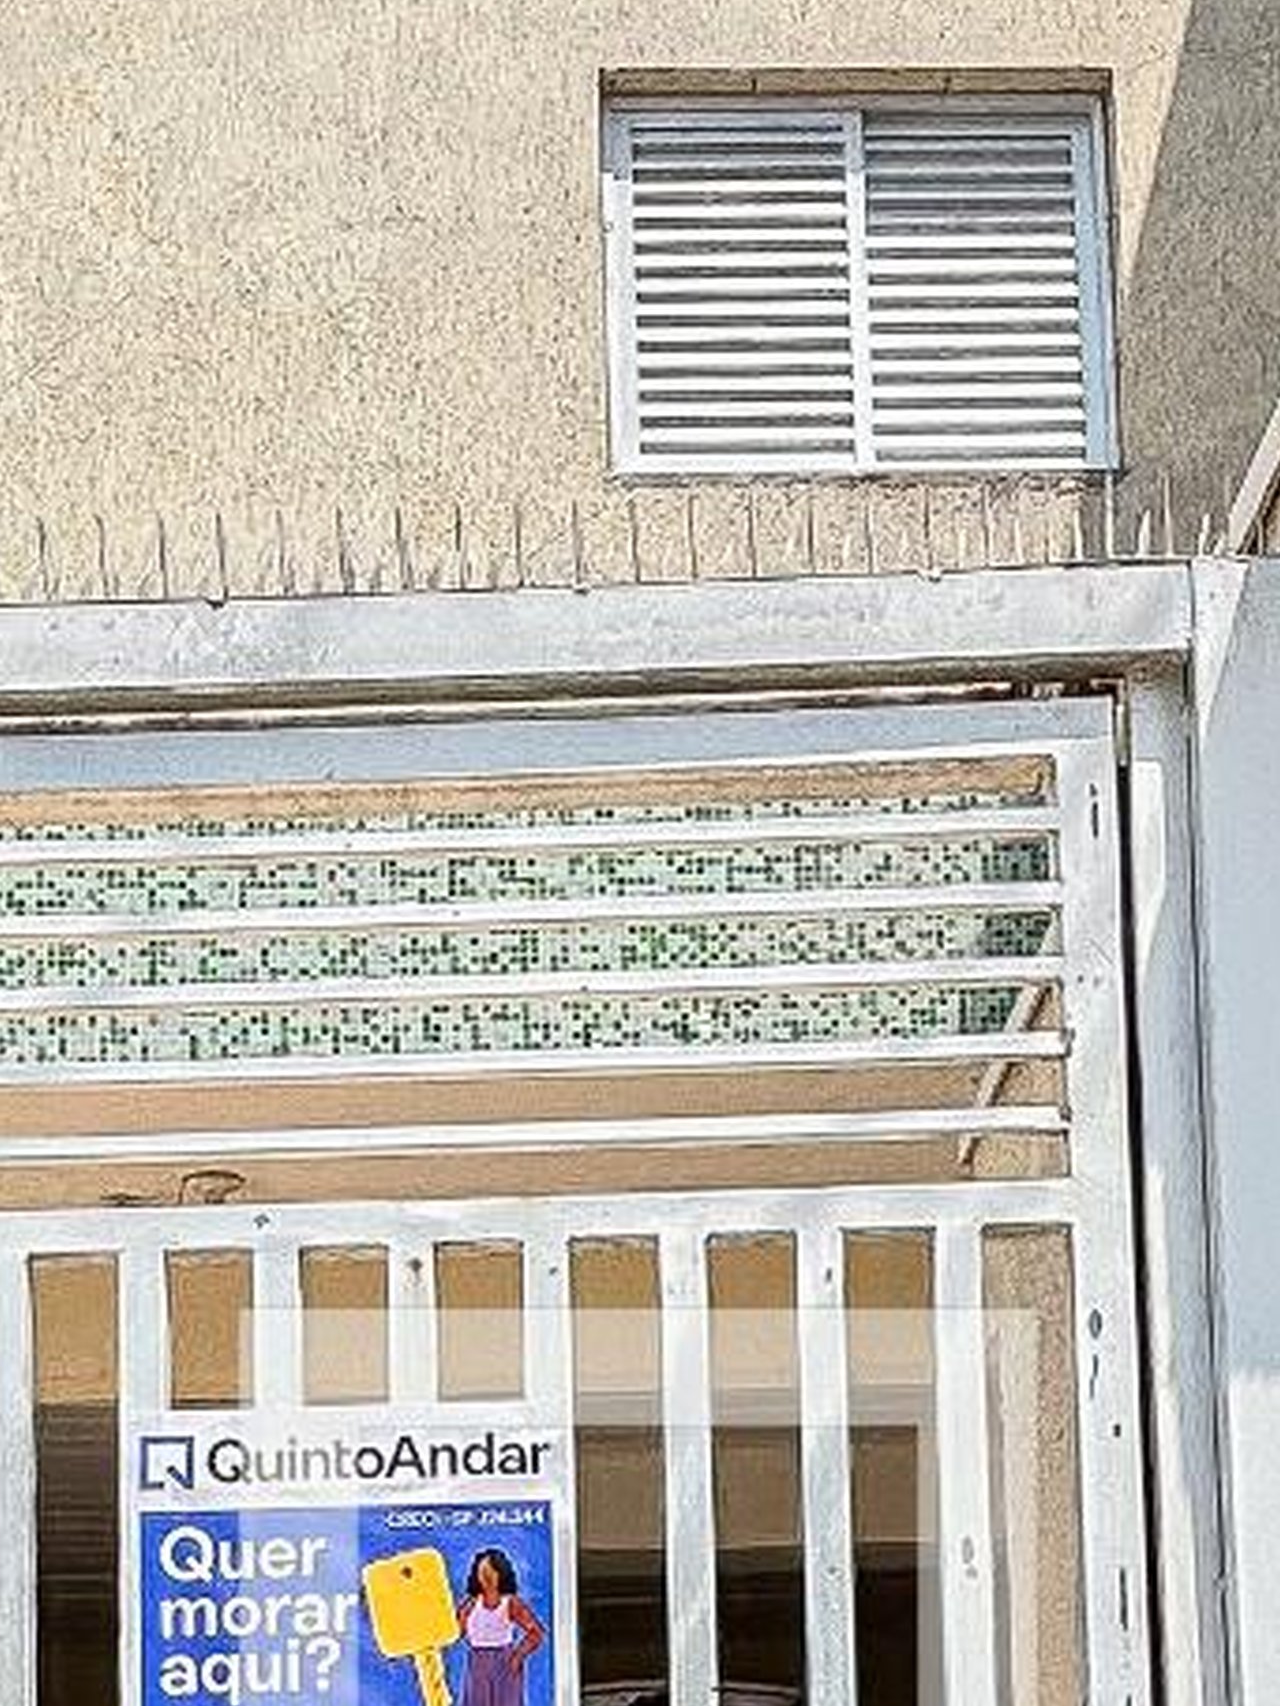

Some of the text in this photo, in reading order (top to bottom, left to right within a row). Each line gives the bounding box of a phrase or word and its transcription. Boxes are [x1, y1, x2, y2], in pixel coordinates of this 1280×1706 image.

[207, 1432, 551, 1483] QuintoAndar
[158, 1526, 328, 1582] Quer
[161, 1593, 359, 1638] morar
[158, 1639, 342, 1706] aqui?
